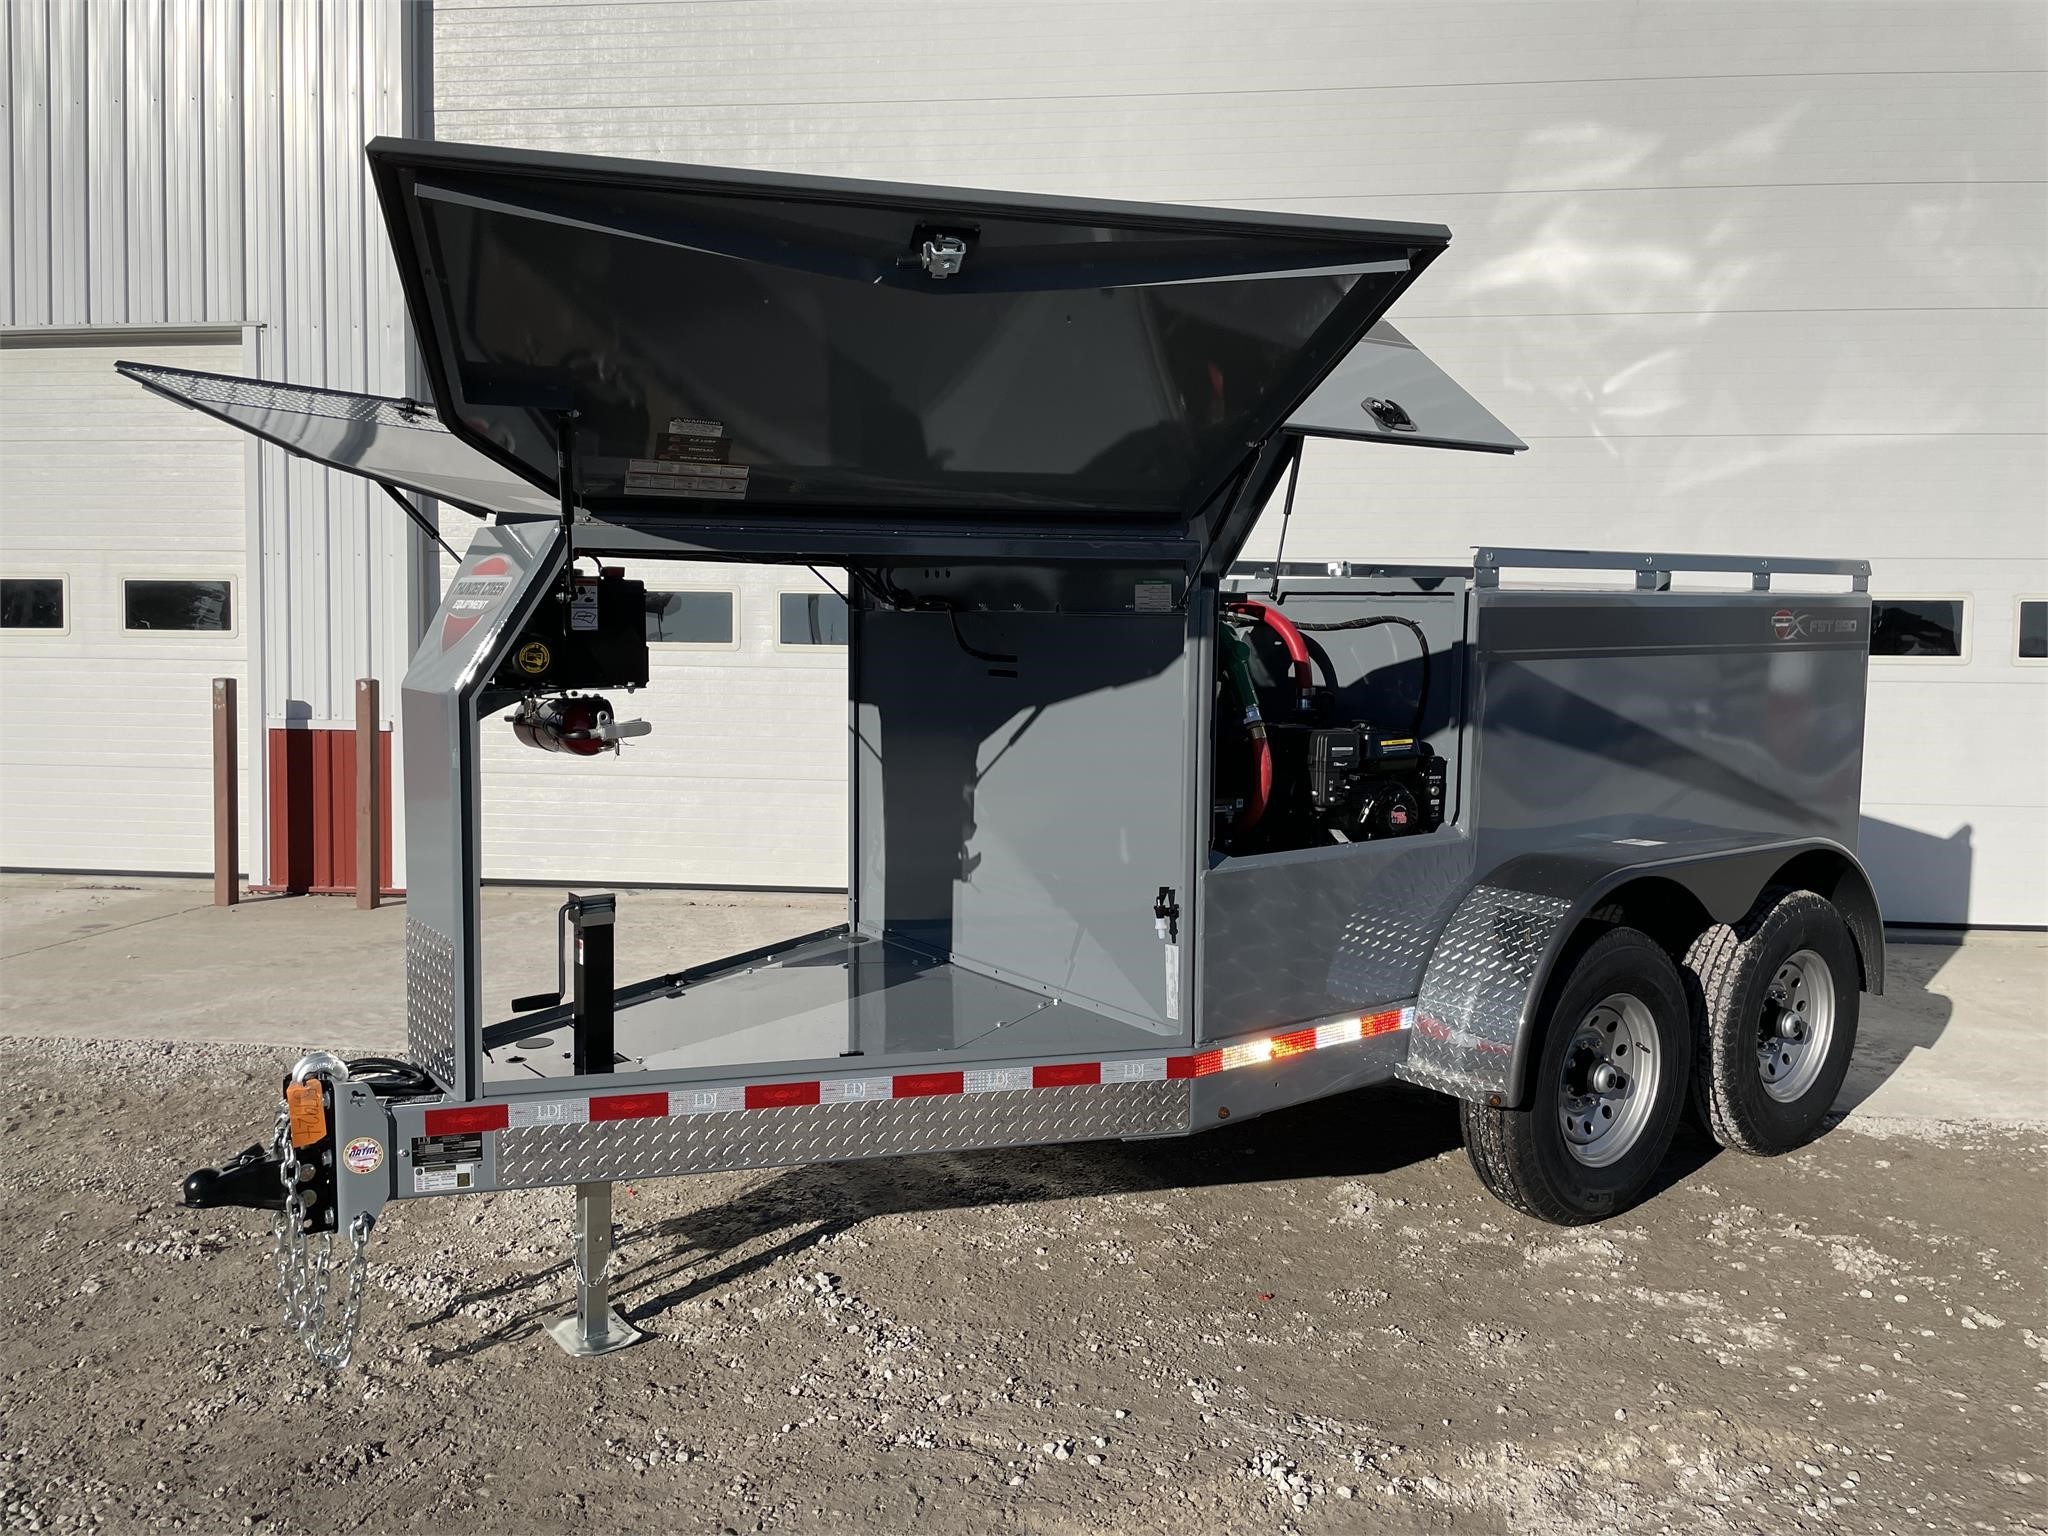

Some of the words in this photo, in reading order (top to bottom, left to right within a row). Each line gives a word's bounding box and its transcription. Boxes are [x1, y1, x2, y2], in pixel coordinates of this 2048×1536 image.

[452, 581, 486, 595] THUNDER
[480, 581, 510, 596] CREEK
[452, 600, 489, 610] EQUIPMENT
[843, 1082, 866, 1097] LDJ
[694, 1092, 718, 1109] LDJ
[537, 1104, 563, 1119] LDJ
